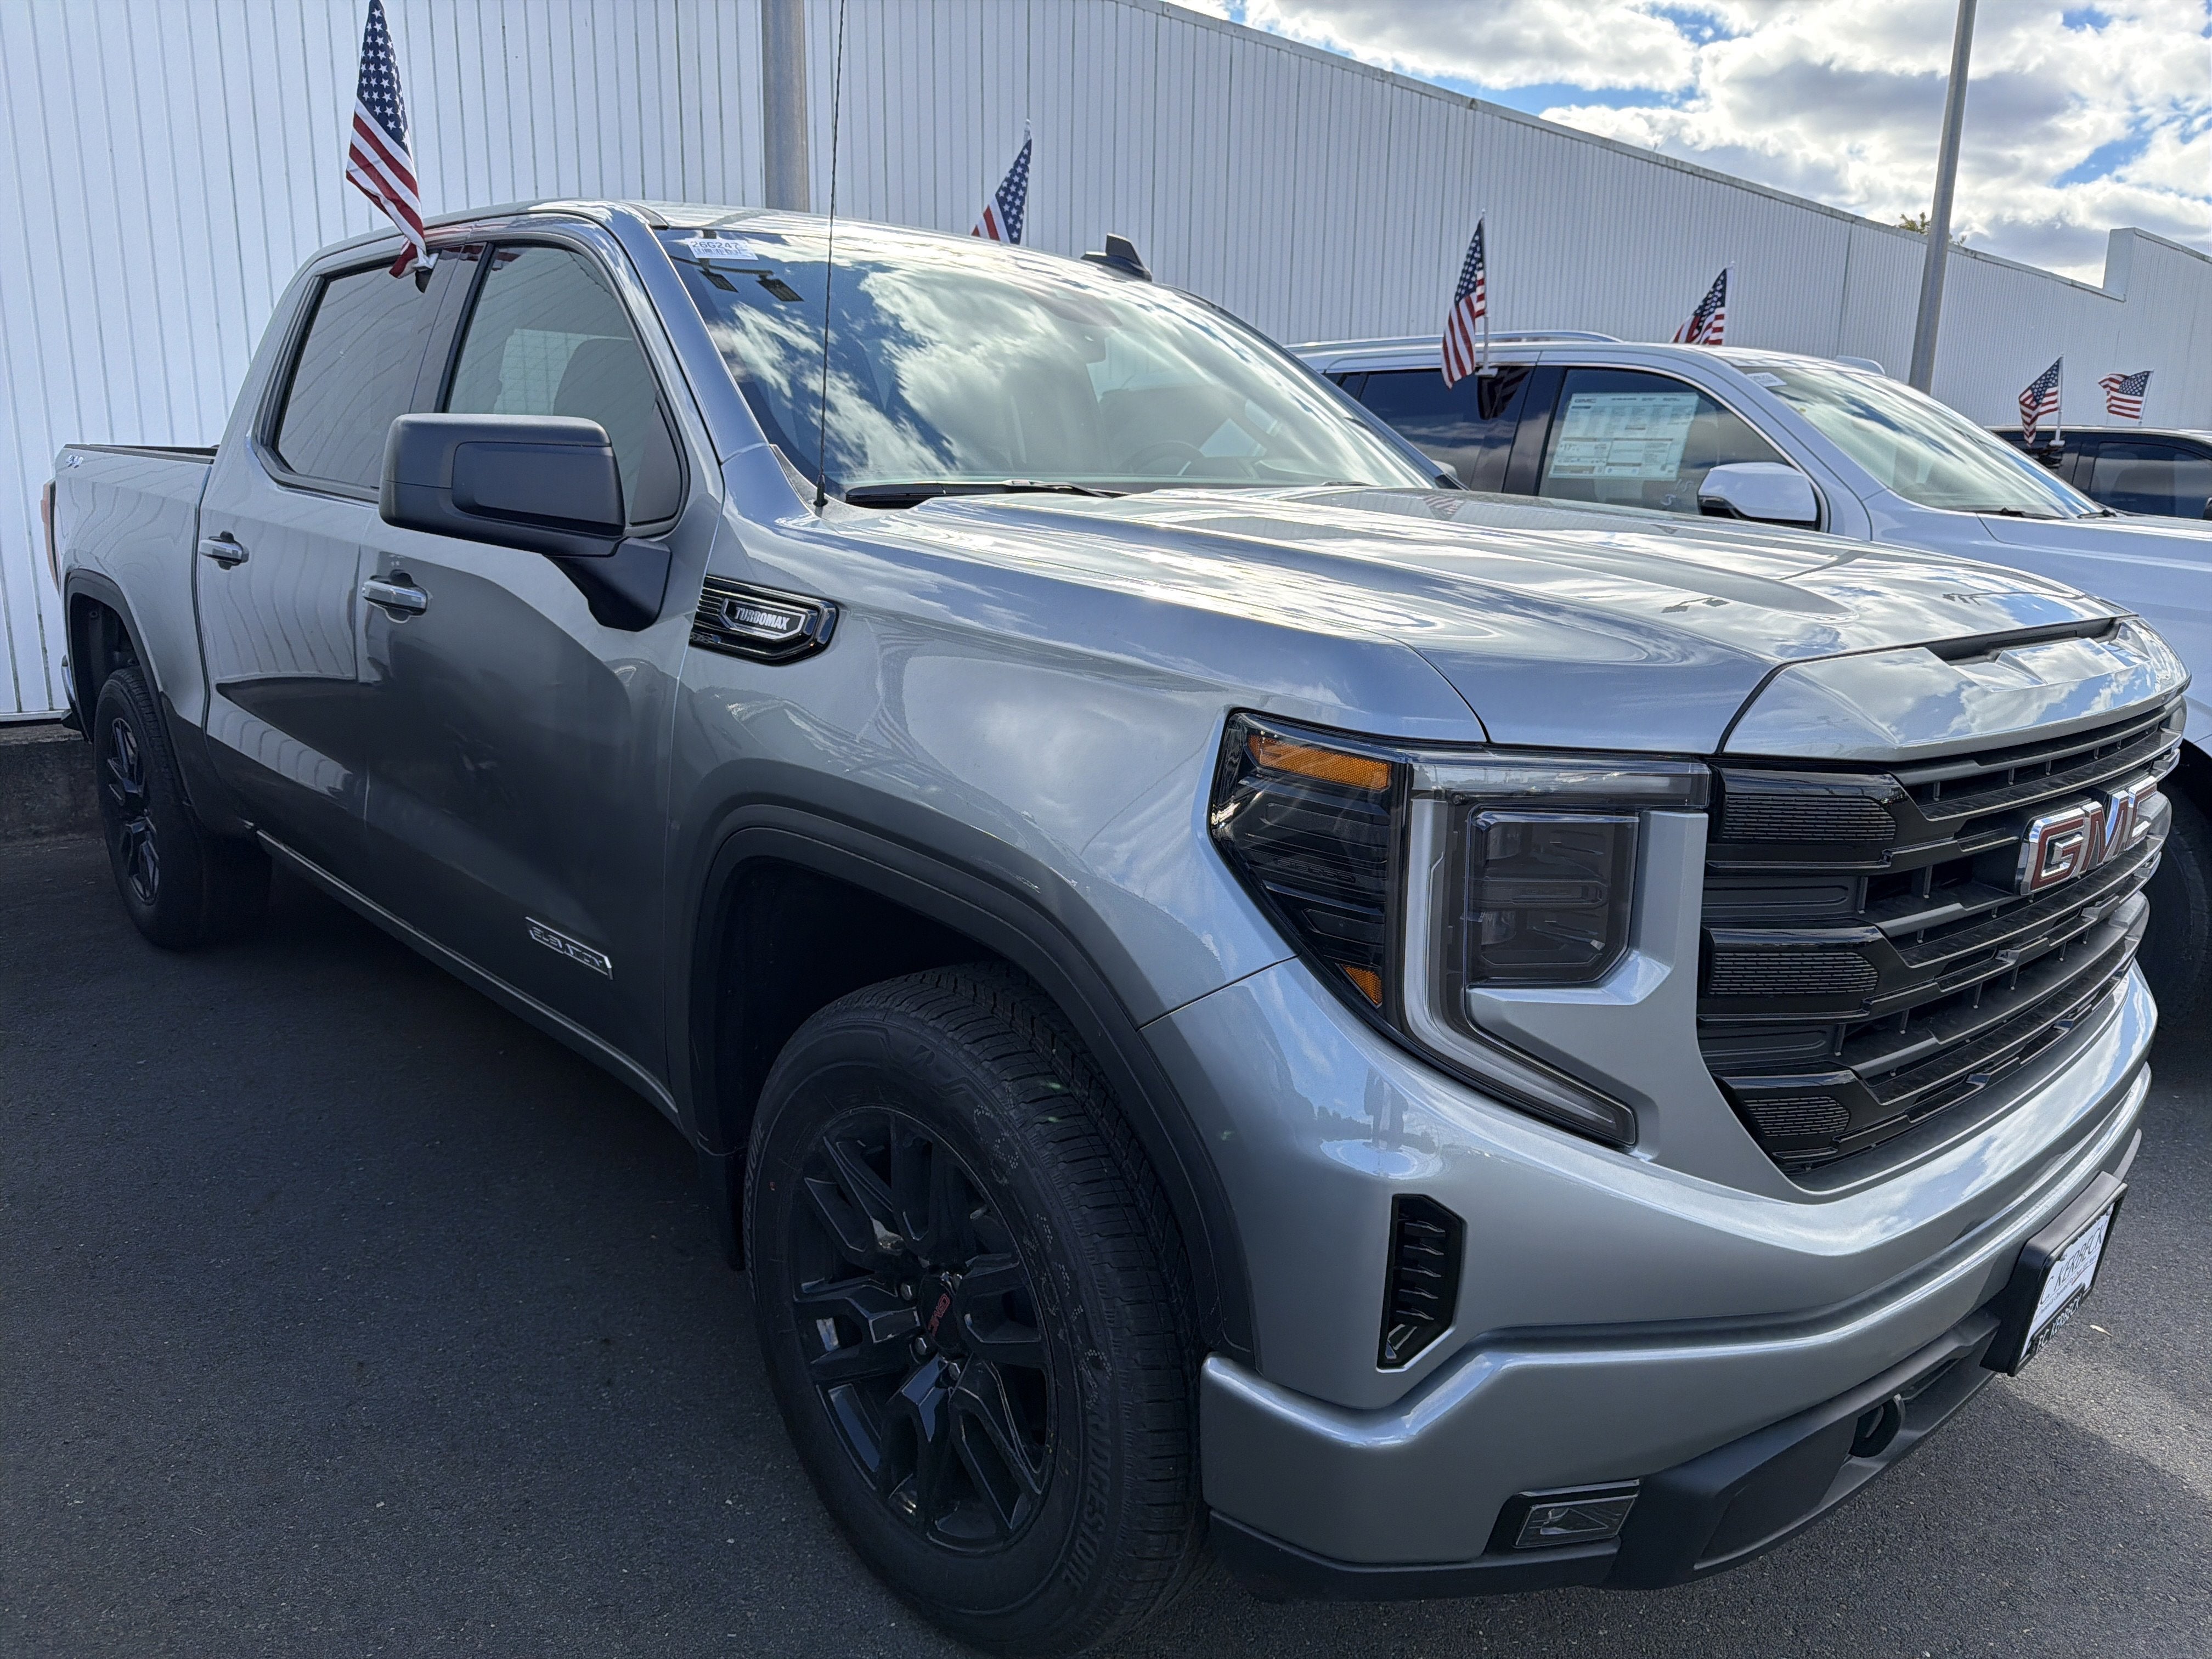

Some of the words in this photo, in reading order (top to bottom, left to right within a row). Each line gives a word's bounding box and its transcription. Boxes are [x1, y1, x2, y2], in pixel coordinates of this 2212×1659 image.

[691, 241, 738, 251] 26G247
[735, 606, 790, 630] TURBOMAX
[2021, 776, 2157, 895] GMC
[532, 926, 603, 967] ELEVATION
[2053, 1220, 2108, 1293] KERBECK
[2050, 1293, 2083, 1339] KERBECK
[1062, 1395, 1112, 1590] RIDGESTONE
